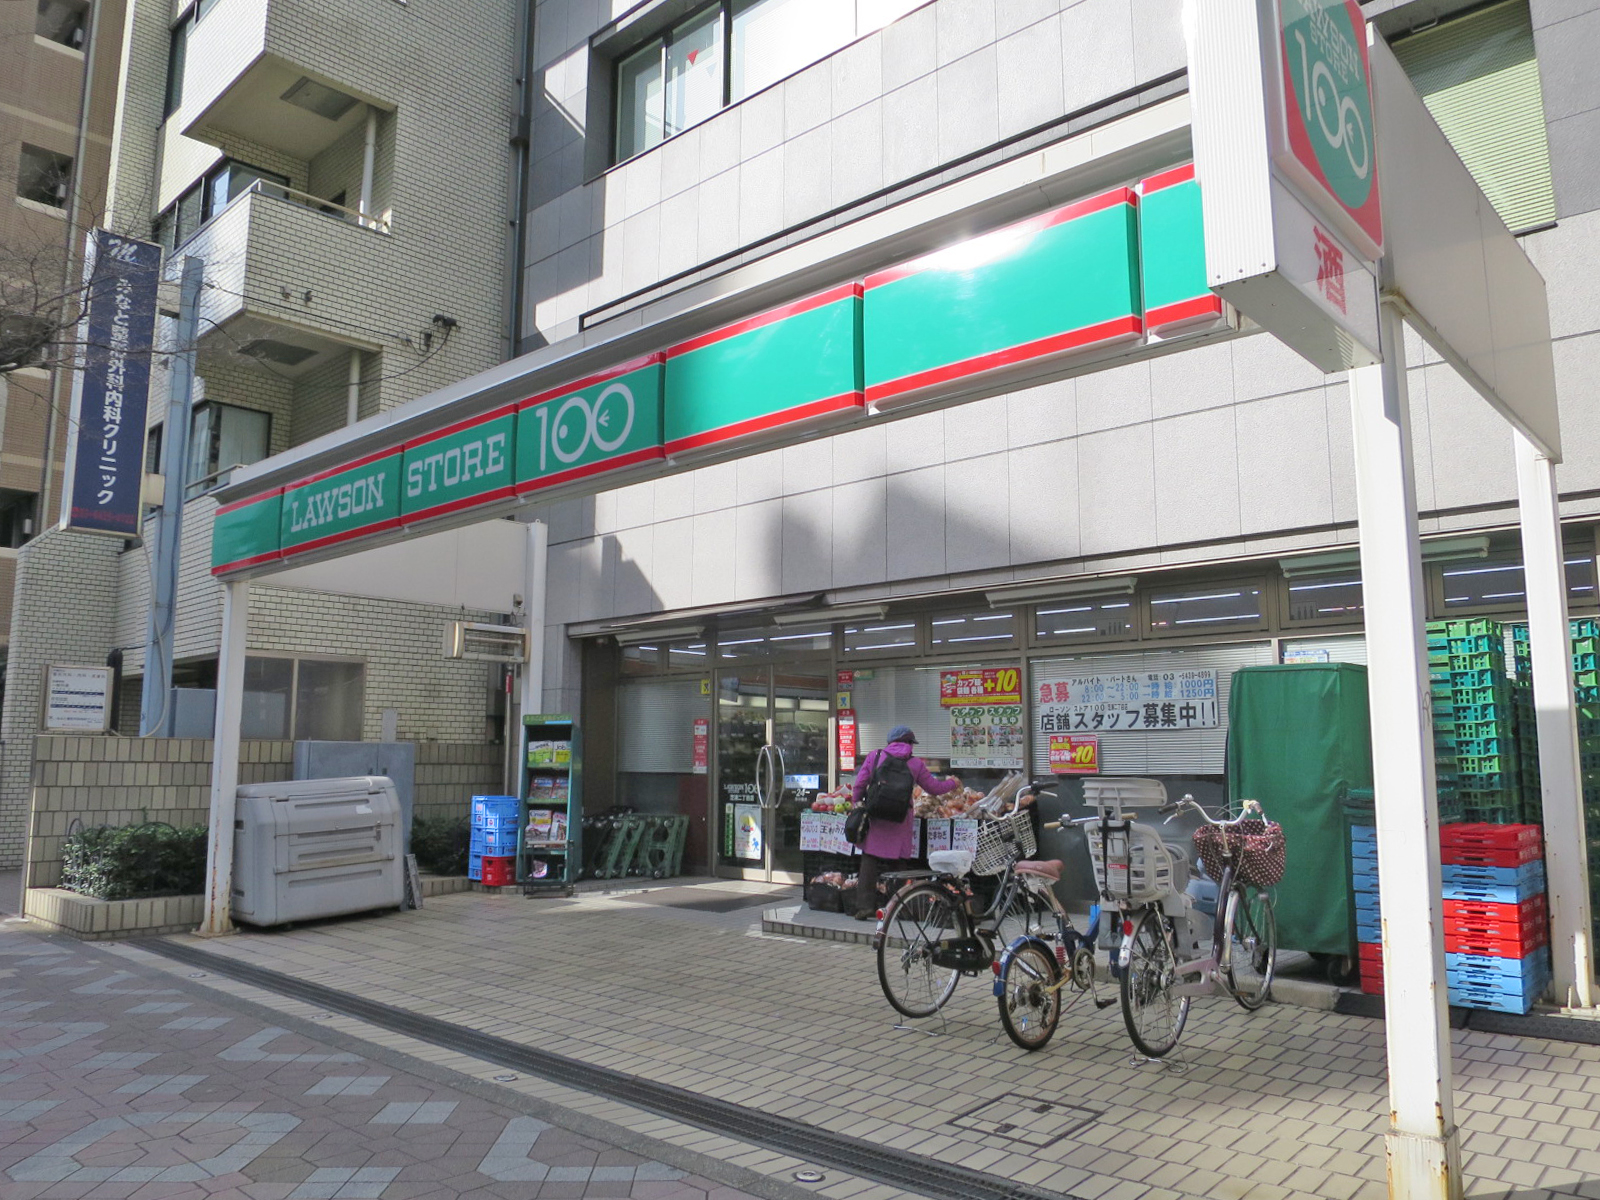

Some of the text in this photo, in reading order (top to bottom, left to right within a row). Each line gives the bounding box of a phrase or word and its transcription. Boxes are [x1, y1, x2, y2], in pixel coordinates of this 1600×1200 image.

[1295, 29, 1368, 180] 100
[1313, 225, 1347, 316] 酒
[291, 382, 635, 533] LAWSON STORE 100
[1162, 673, 1175, 681] 03
[1180, 678, 1214, 689] 1000円
[1039, 681, 1070, 703] 急募
[1180, 688, 1214, 698] 1250円
[953, 708, 983, 716] スタッフ
[989, 706, 1020, 715] スタッフ
